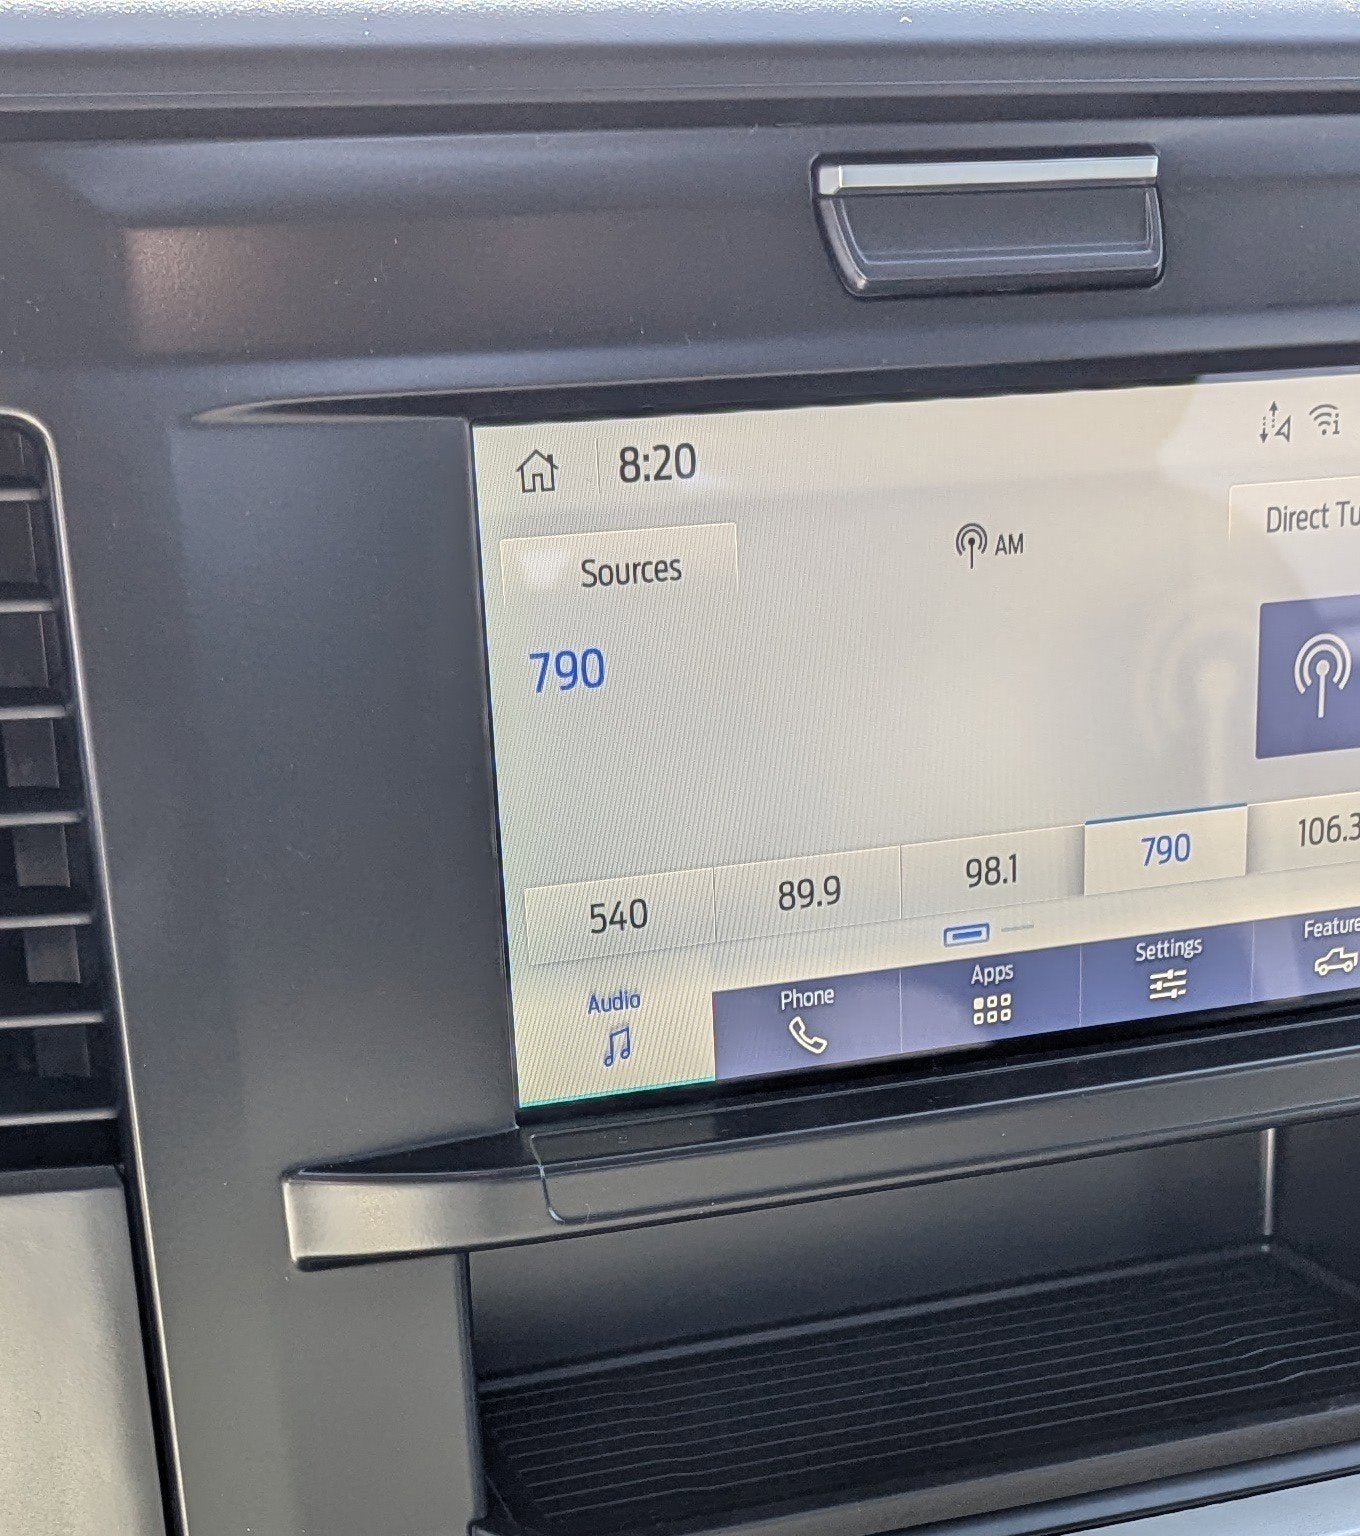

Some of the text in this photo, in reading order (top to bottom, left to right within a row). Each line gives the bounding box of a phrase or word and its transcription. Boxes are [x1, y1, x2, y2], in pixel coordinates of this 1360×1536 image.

[618, 442, 697, 484] 8:20
[1266, 503, 1330, 533] Direct
[994, 532, 1024, 556] AM
[580, 558, 683, 588] Sources
[528, 647, 606, 694] 790
[1140, 832, 1192, 868] 790
[965, 853, 1019, 889] 98.1
[778, 874, 842, 911] 89.9
[589, 897, 649, 935] 540
[1135, 936, 1203, 963] Settings
[971, 961, 1015, 986] Apps
[586, 988, 642, 1016] Audio
[780, 985, 835, 1012] Phone
